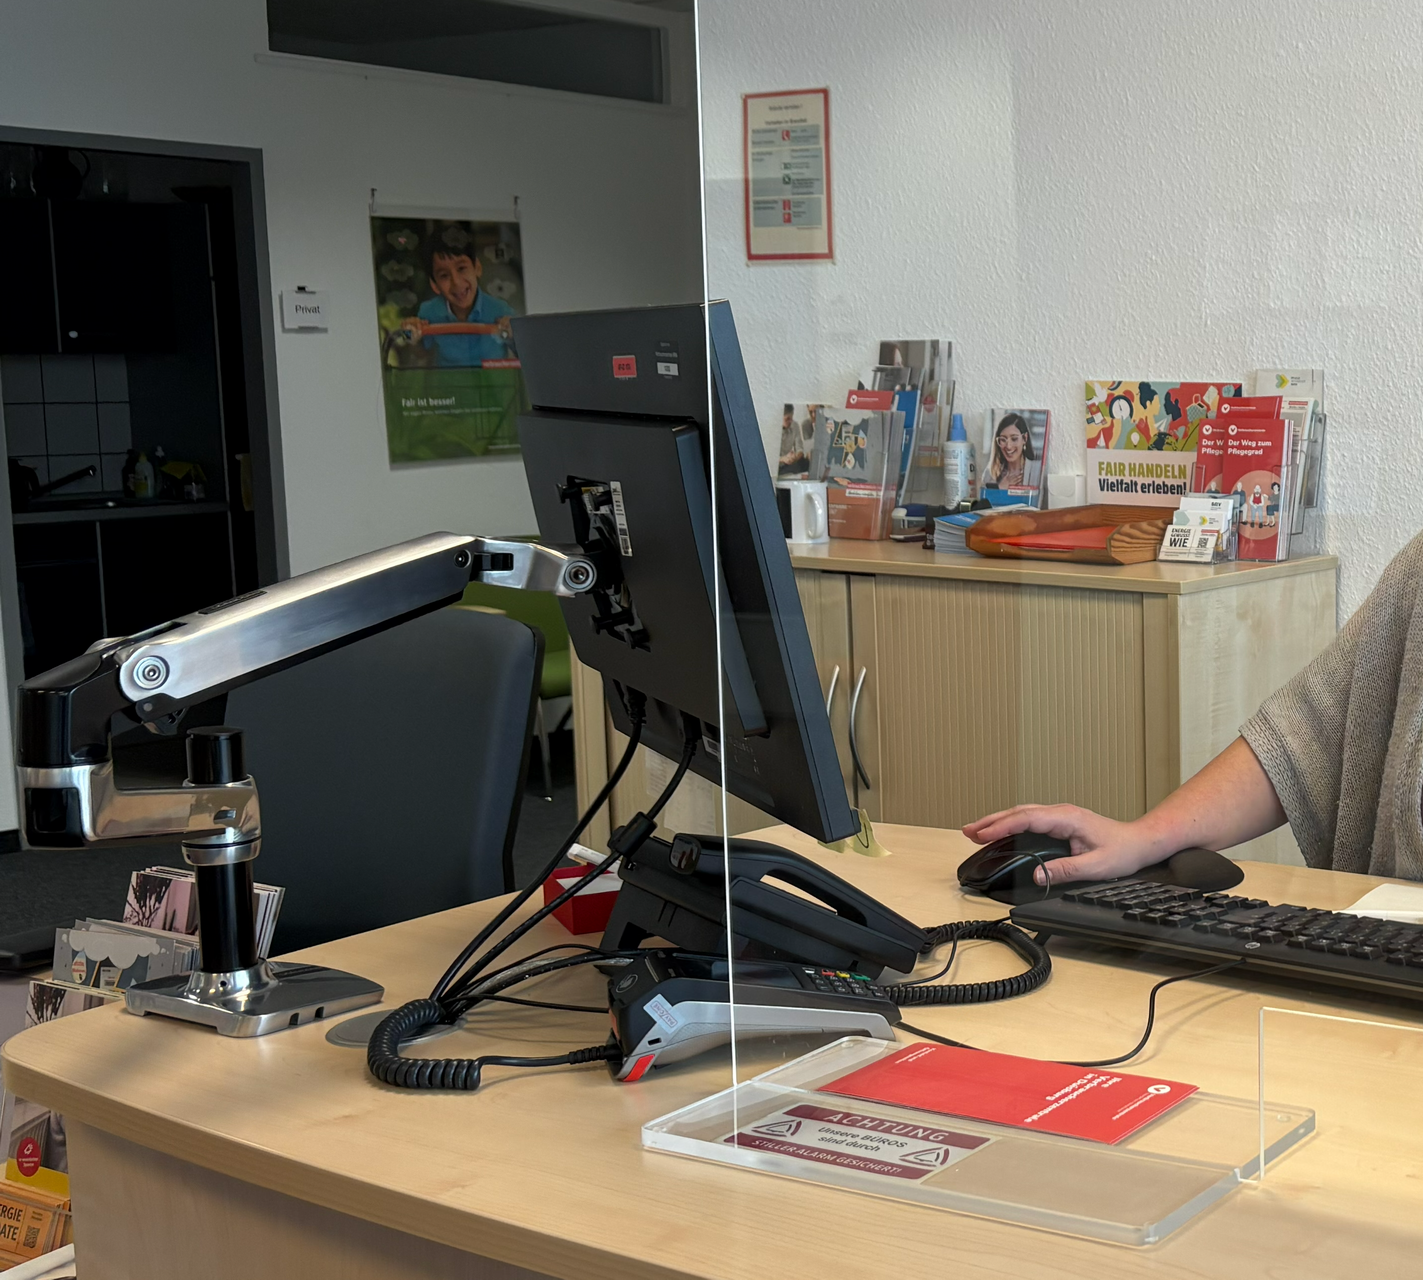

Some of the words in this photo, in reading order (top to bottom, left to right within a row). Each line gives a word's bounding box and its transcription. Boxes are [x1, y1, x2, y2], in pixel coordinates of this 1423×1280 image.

[295, 304, 321, 314] Privat
[402, 397, 416, 407] Fair
[417, 397, 427, 406] ist
[429, 396, 455, 406] besser!
[1201, 447, 1224, 455] Pflege
[1241, 439, 1256, 447] Weg
[1228, 448, 1263, 456] Pflegegrad
[1098, 461, 1126, 477] FAIR
[1128, 462, 1187, 480] HANDELN
[1098, 478, 1138, 493] Vielfalt
[1140, 480, 1187, 495] erleben!
[1169, 538, 1189, 548] WIE
[823, 1112, 949, 1142] ACHTUNG
[817, 1126, 860, 1139] Unsere
[863, 1132, 908, 1148] BÜROS
[818, 1135, 844, 1146] sind
[846, 1139, 882, 1152] durch
[797, 1147, 836, 1161] ALARM
[836, 1155, 902, 1174] GESICHERT!
[0, 1223, 19, 1241] ATE
